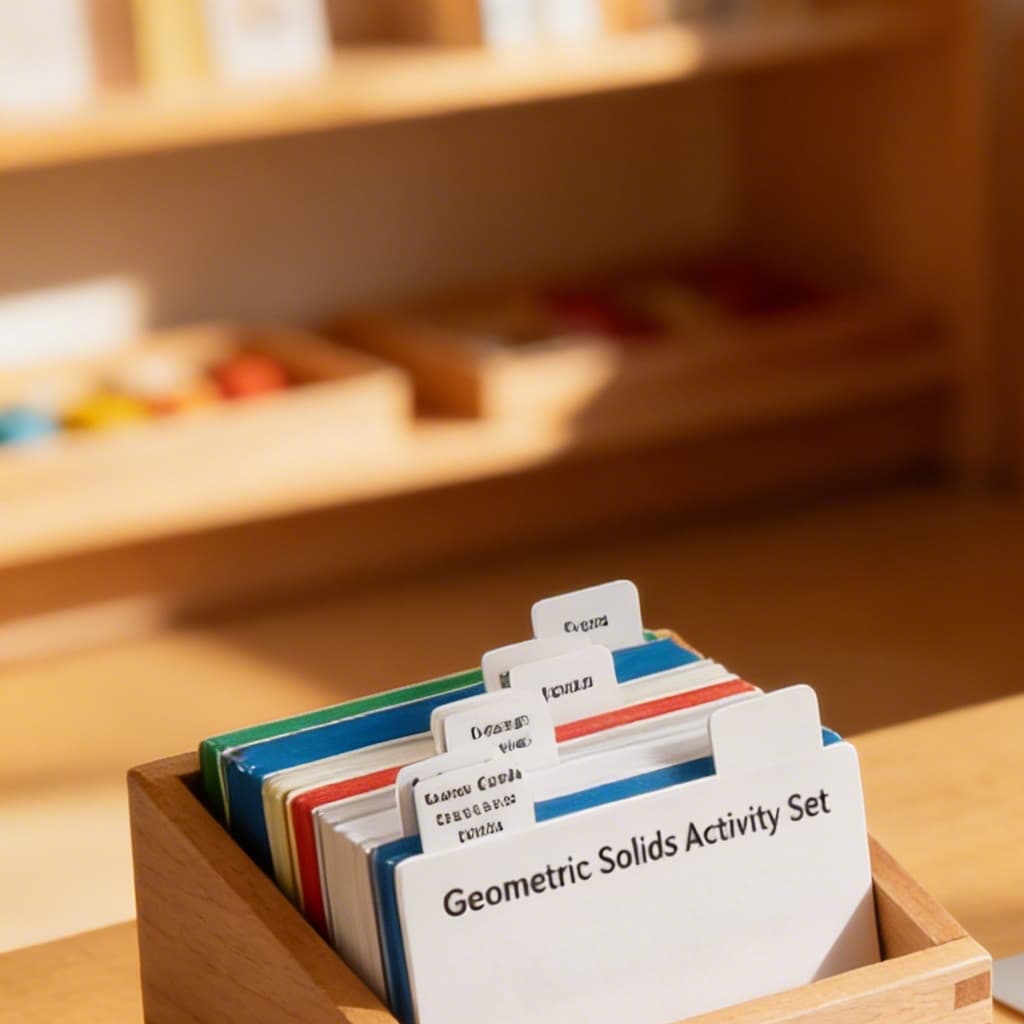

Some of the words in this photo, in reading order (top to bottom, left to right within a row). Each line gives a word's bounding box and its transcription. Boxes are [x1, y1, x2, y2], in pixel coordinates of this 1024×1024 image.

[443, 855, 593, 918] Geometric
[597, 829, 679, 875] Solids
[685, 805, 780, 853] Activity
[787, 789, 831, 822] Set
